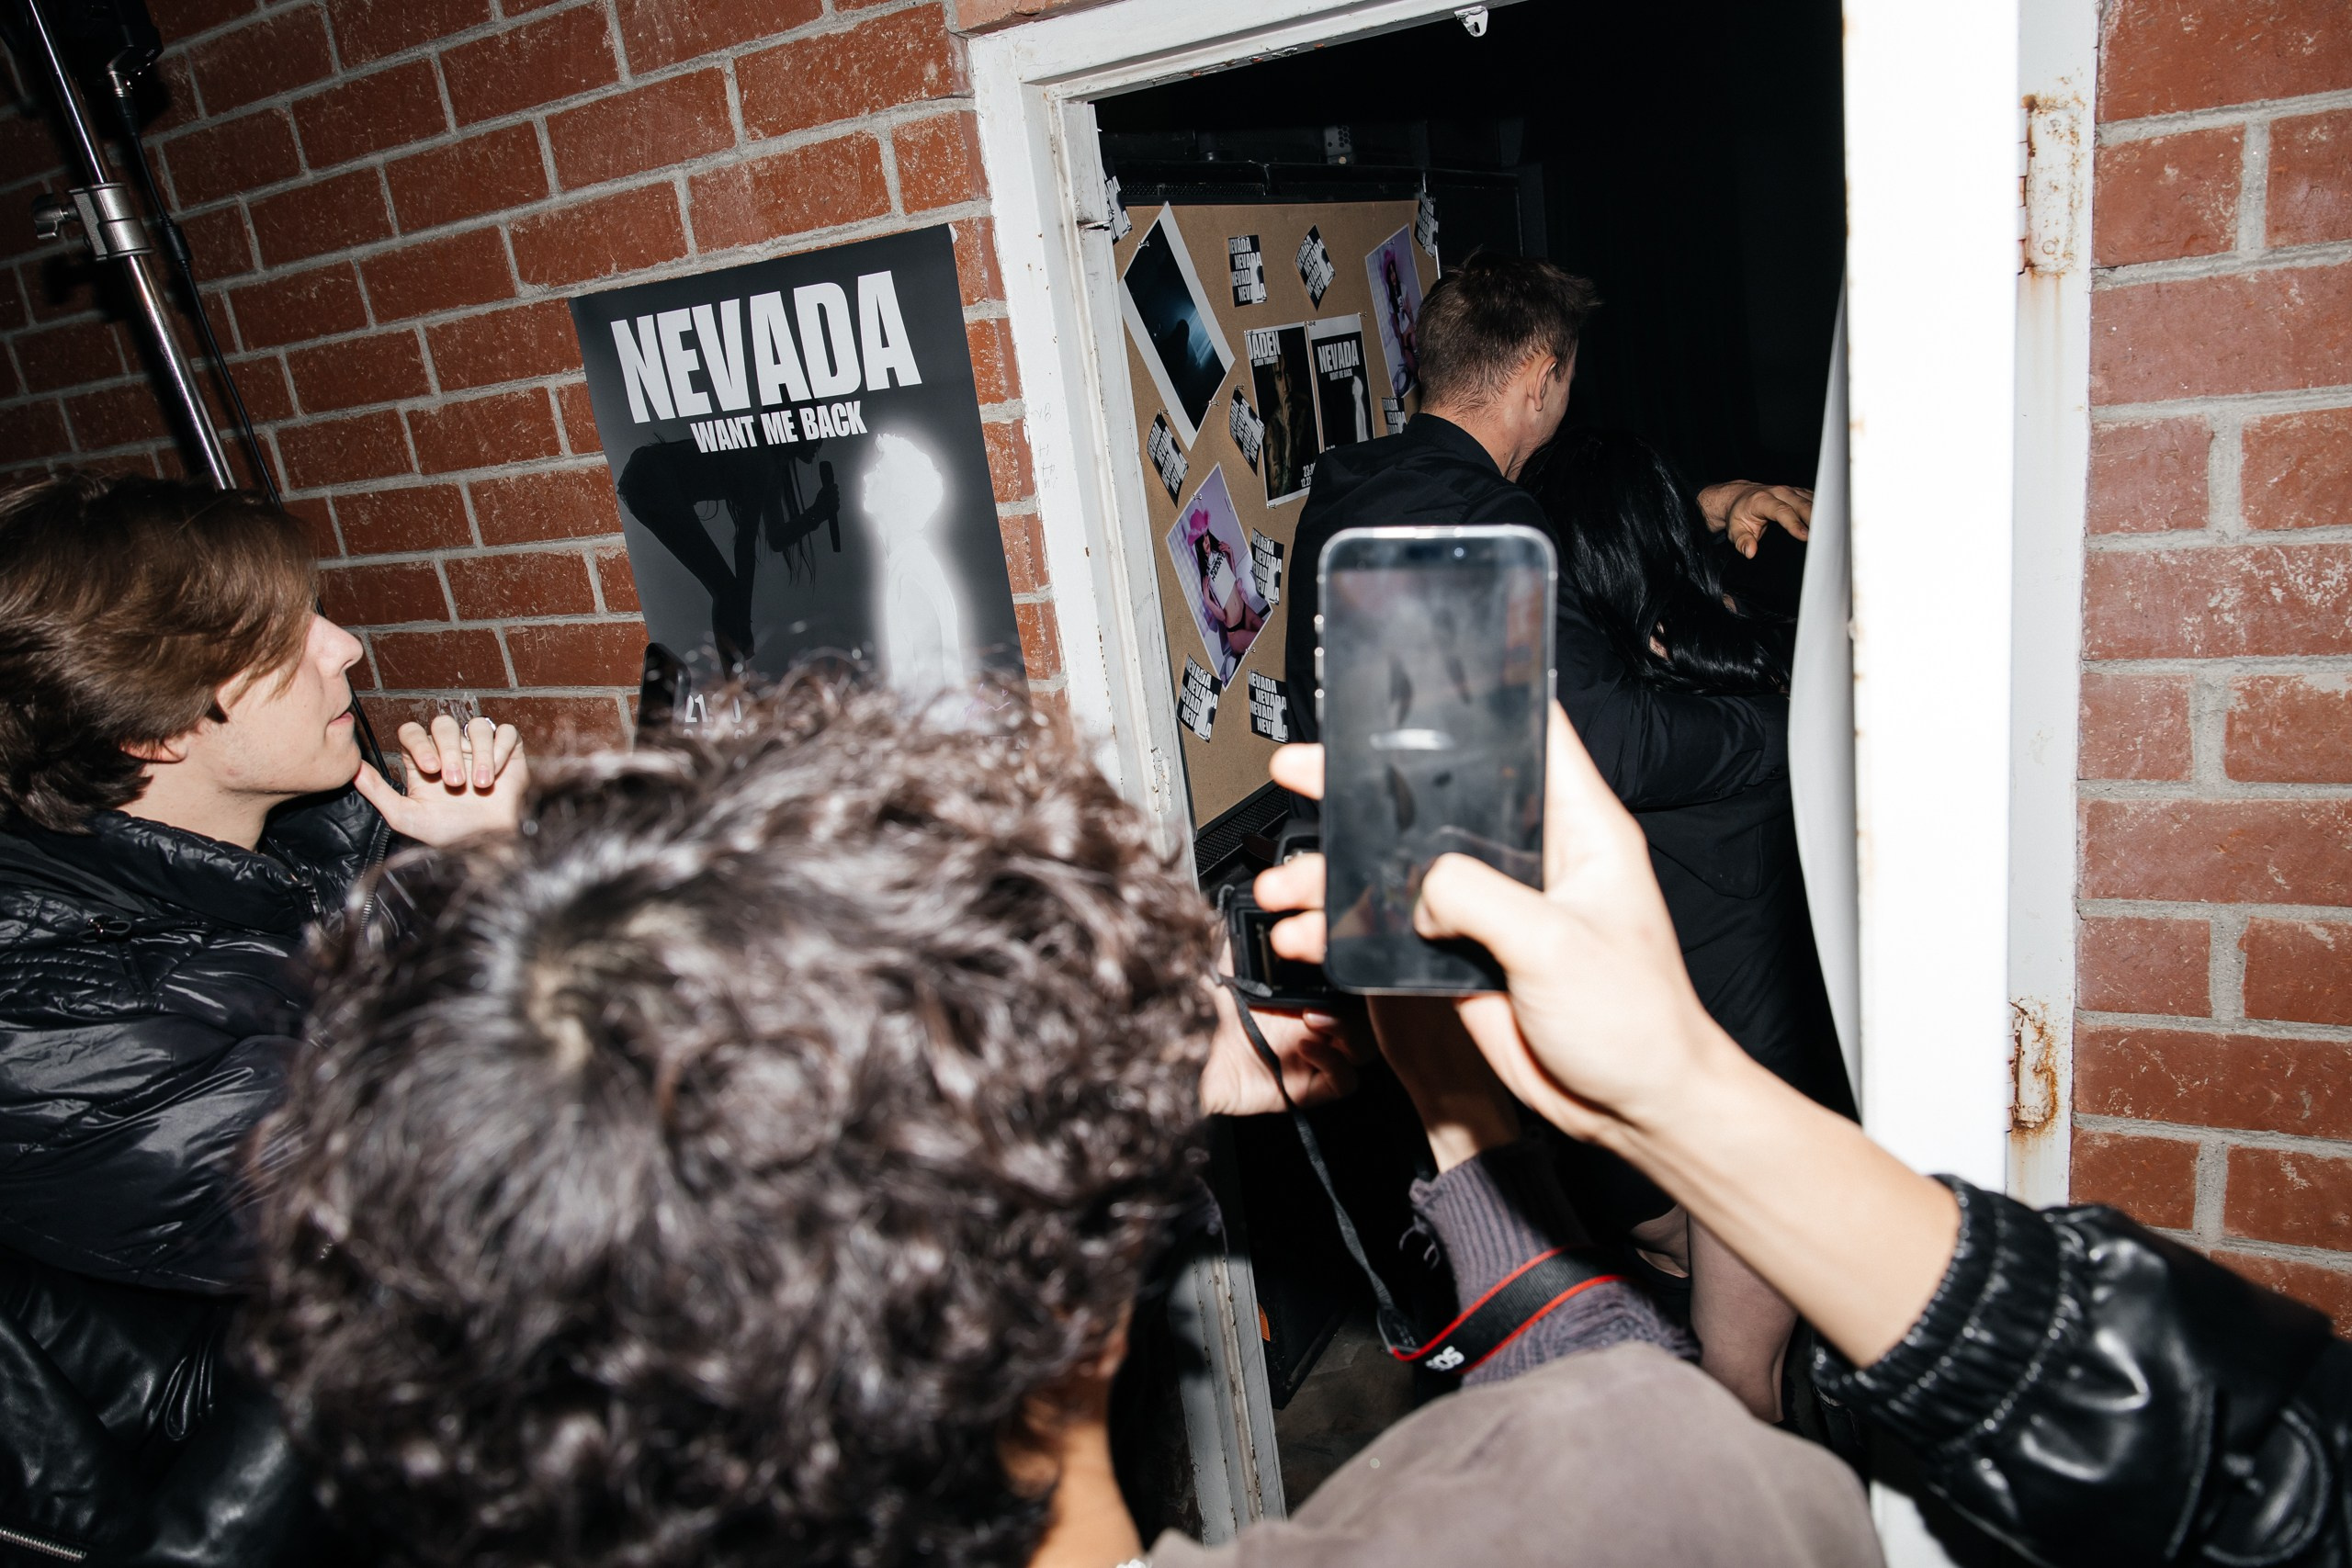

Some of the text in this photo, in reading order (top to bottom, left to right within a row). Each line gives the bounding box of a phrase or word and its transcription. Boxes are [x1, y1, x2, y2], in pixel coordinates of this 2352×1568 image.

[611, 270, 922, 423] NEVADA
[1248, 331, 1281, 360] JADEN
[1317, 340, 1360, 373] NEVADA
[691, 400, 867, 454] WANT ME BACK
[1187, 674, 1218, 709] NEVADA
[1250, 671, 1277, 694] NEVADA
[1256, 688, 1286, 710] NEVADA
